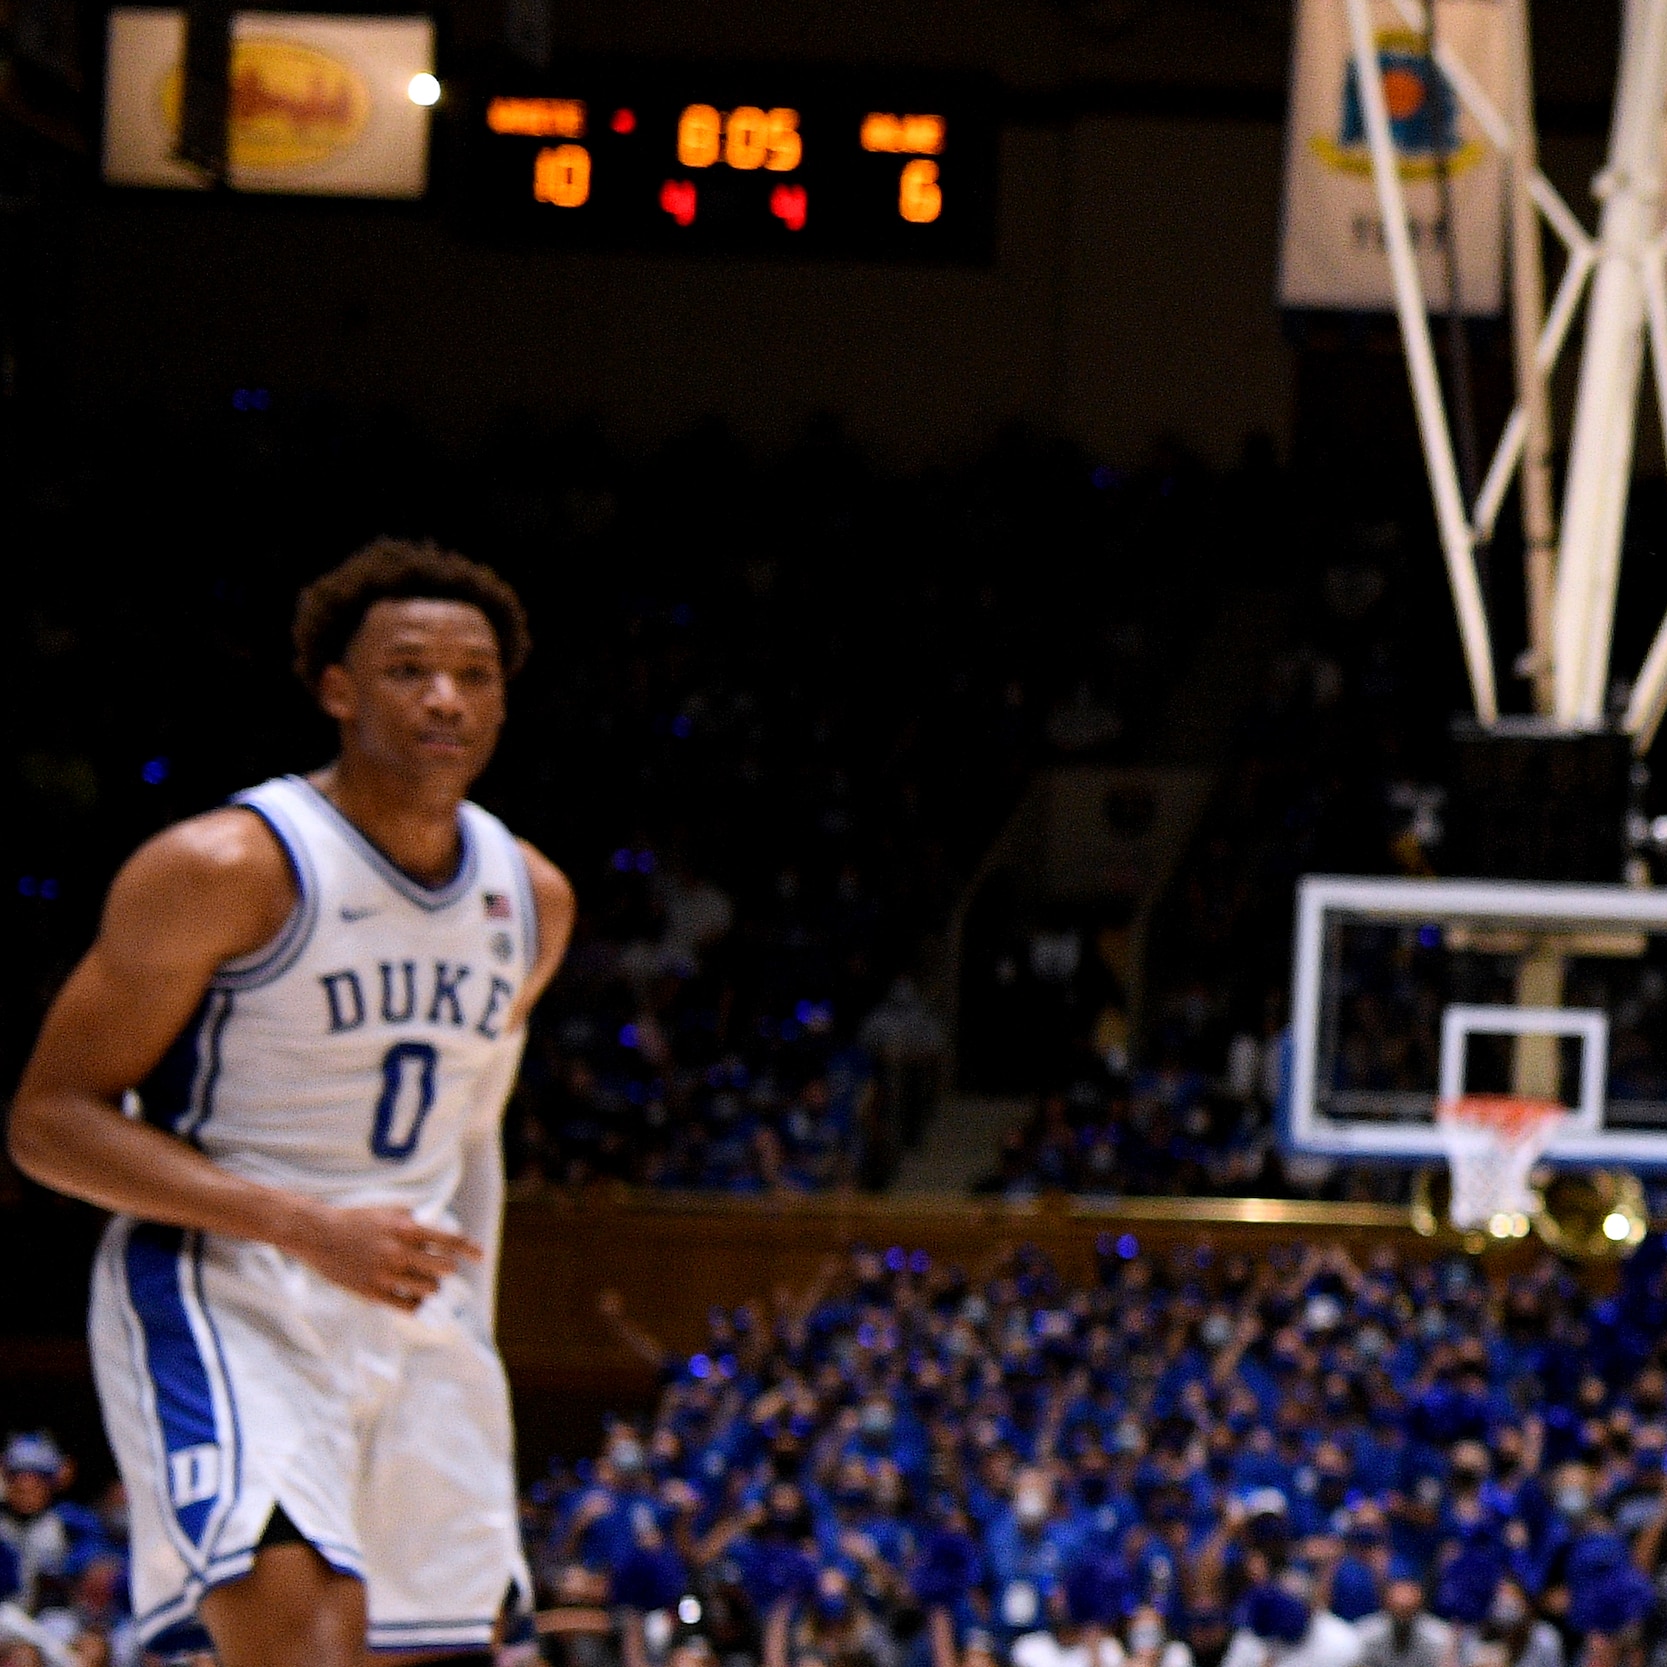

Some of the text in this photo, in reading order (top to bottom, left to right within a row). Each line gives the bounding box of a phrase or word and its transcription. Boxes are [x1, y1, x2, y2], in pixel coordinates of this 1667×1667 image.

[899, 159, 942, 223] 6
[319, 959, 514, 1039] DUKE
[371, 1040, 439, 1163] 0
